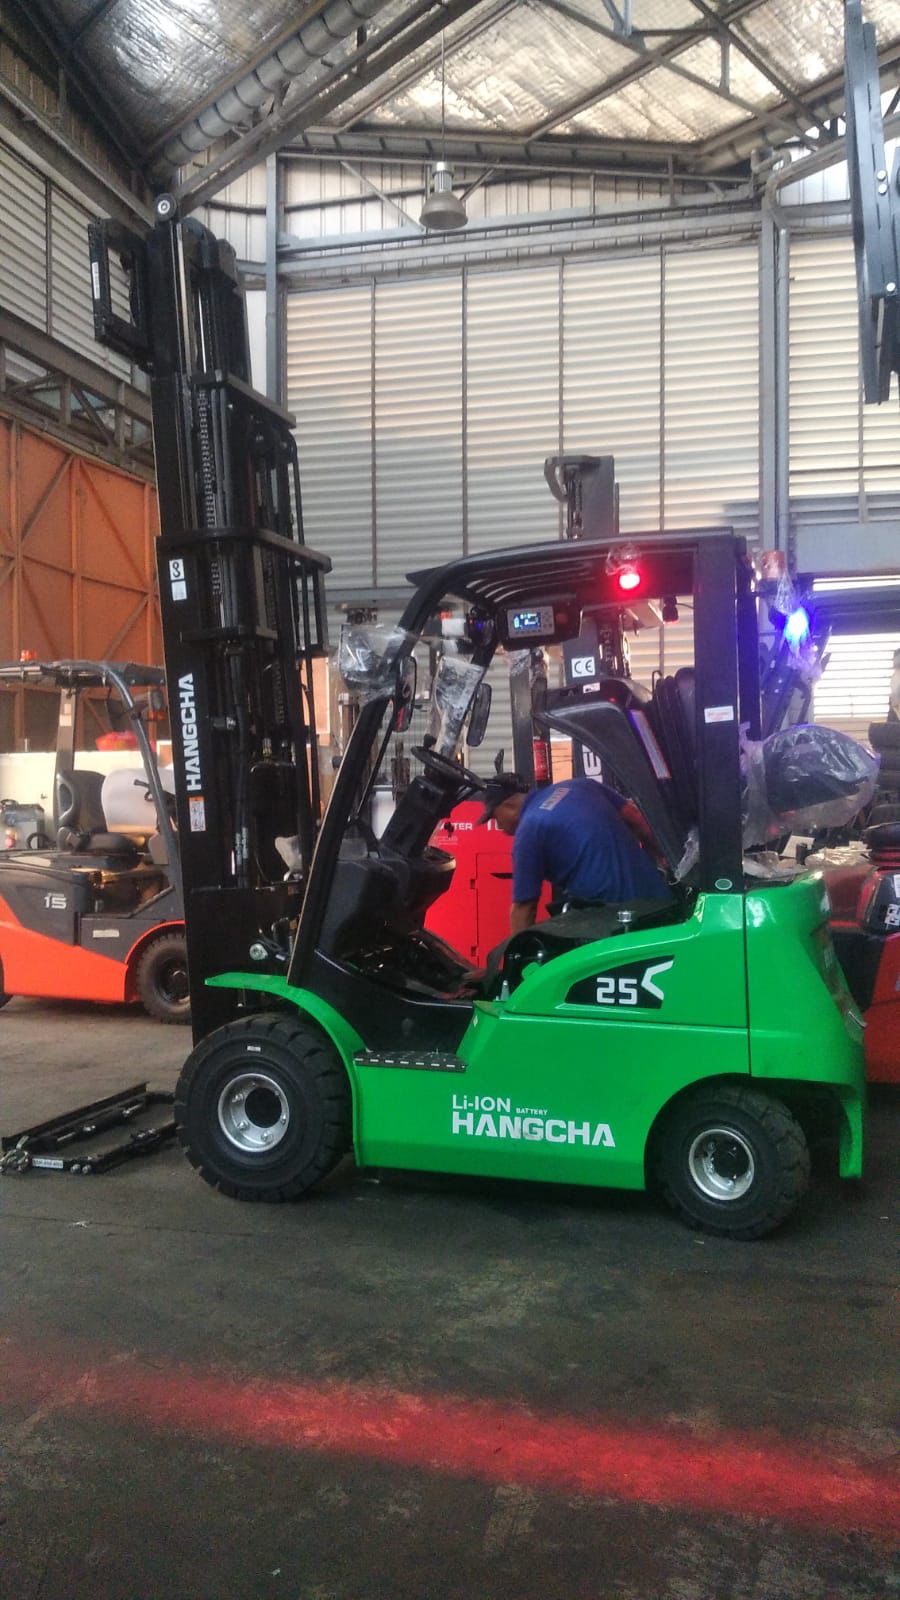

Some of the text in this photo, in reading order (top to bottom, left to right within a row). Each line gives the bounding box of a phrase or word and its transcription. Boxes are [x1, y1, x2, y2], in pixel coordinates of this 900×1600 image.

[178, 673, 202, 791] HANGCHA
[44, 896, 67, 909] 15
[596, 977, 638, 1005] 25
[452, 1094, 548, 1116] Li-ION BATTERY
[452, 1111, 616, 1148] HANGCHA
